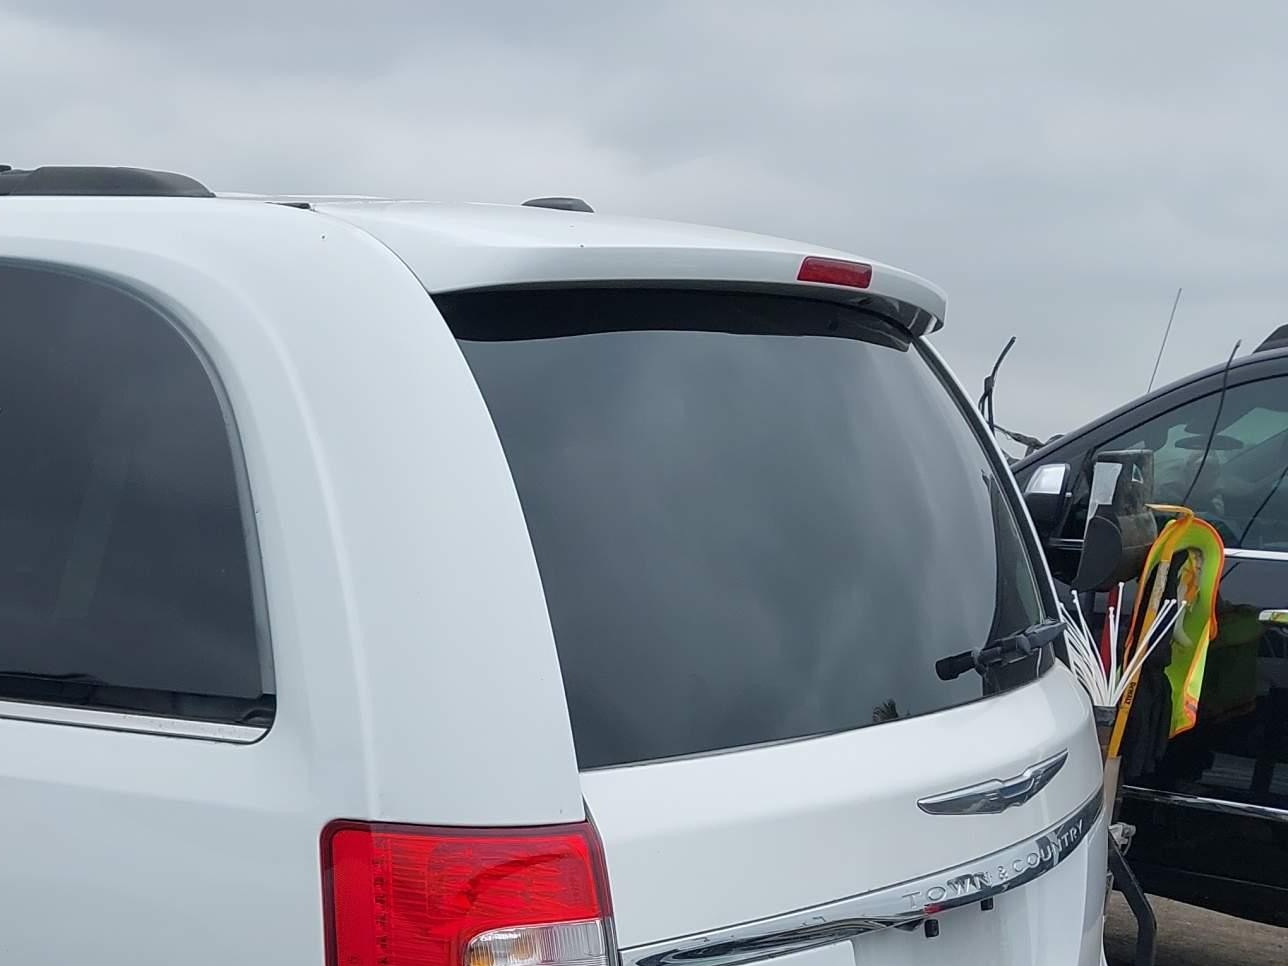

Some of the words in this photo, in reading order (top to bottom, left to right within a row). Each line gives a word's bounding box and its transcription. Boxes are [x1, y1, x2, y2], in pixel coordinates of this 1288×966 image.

[902, 871, 992, 909] TOWN
[998, 866, 1010, 881] &
[1012, 819, 1085, 873] COUNTRY
